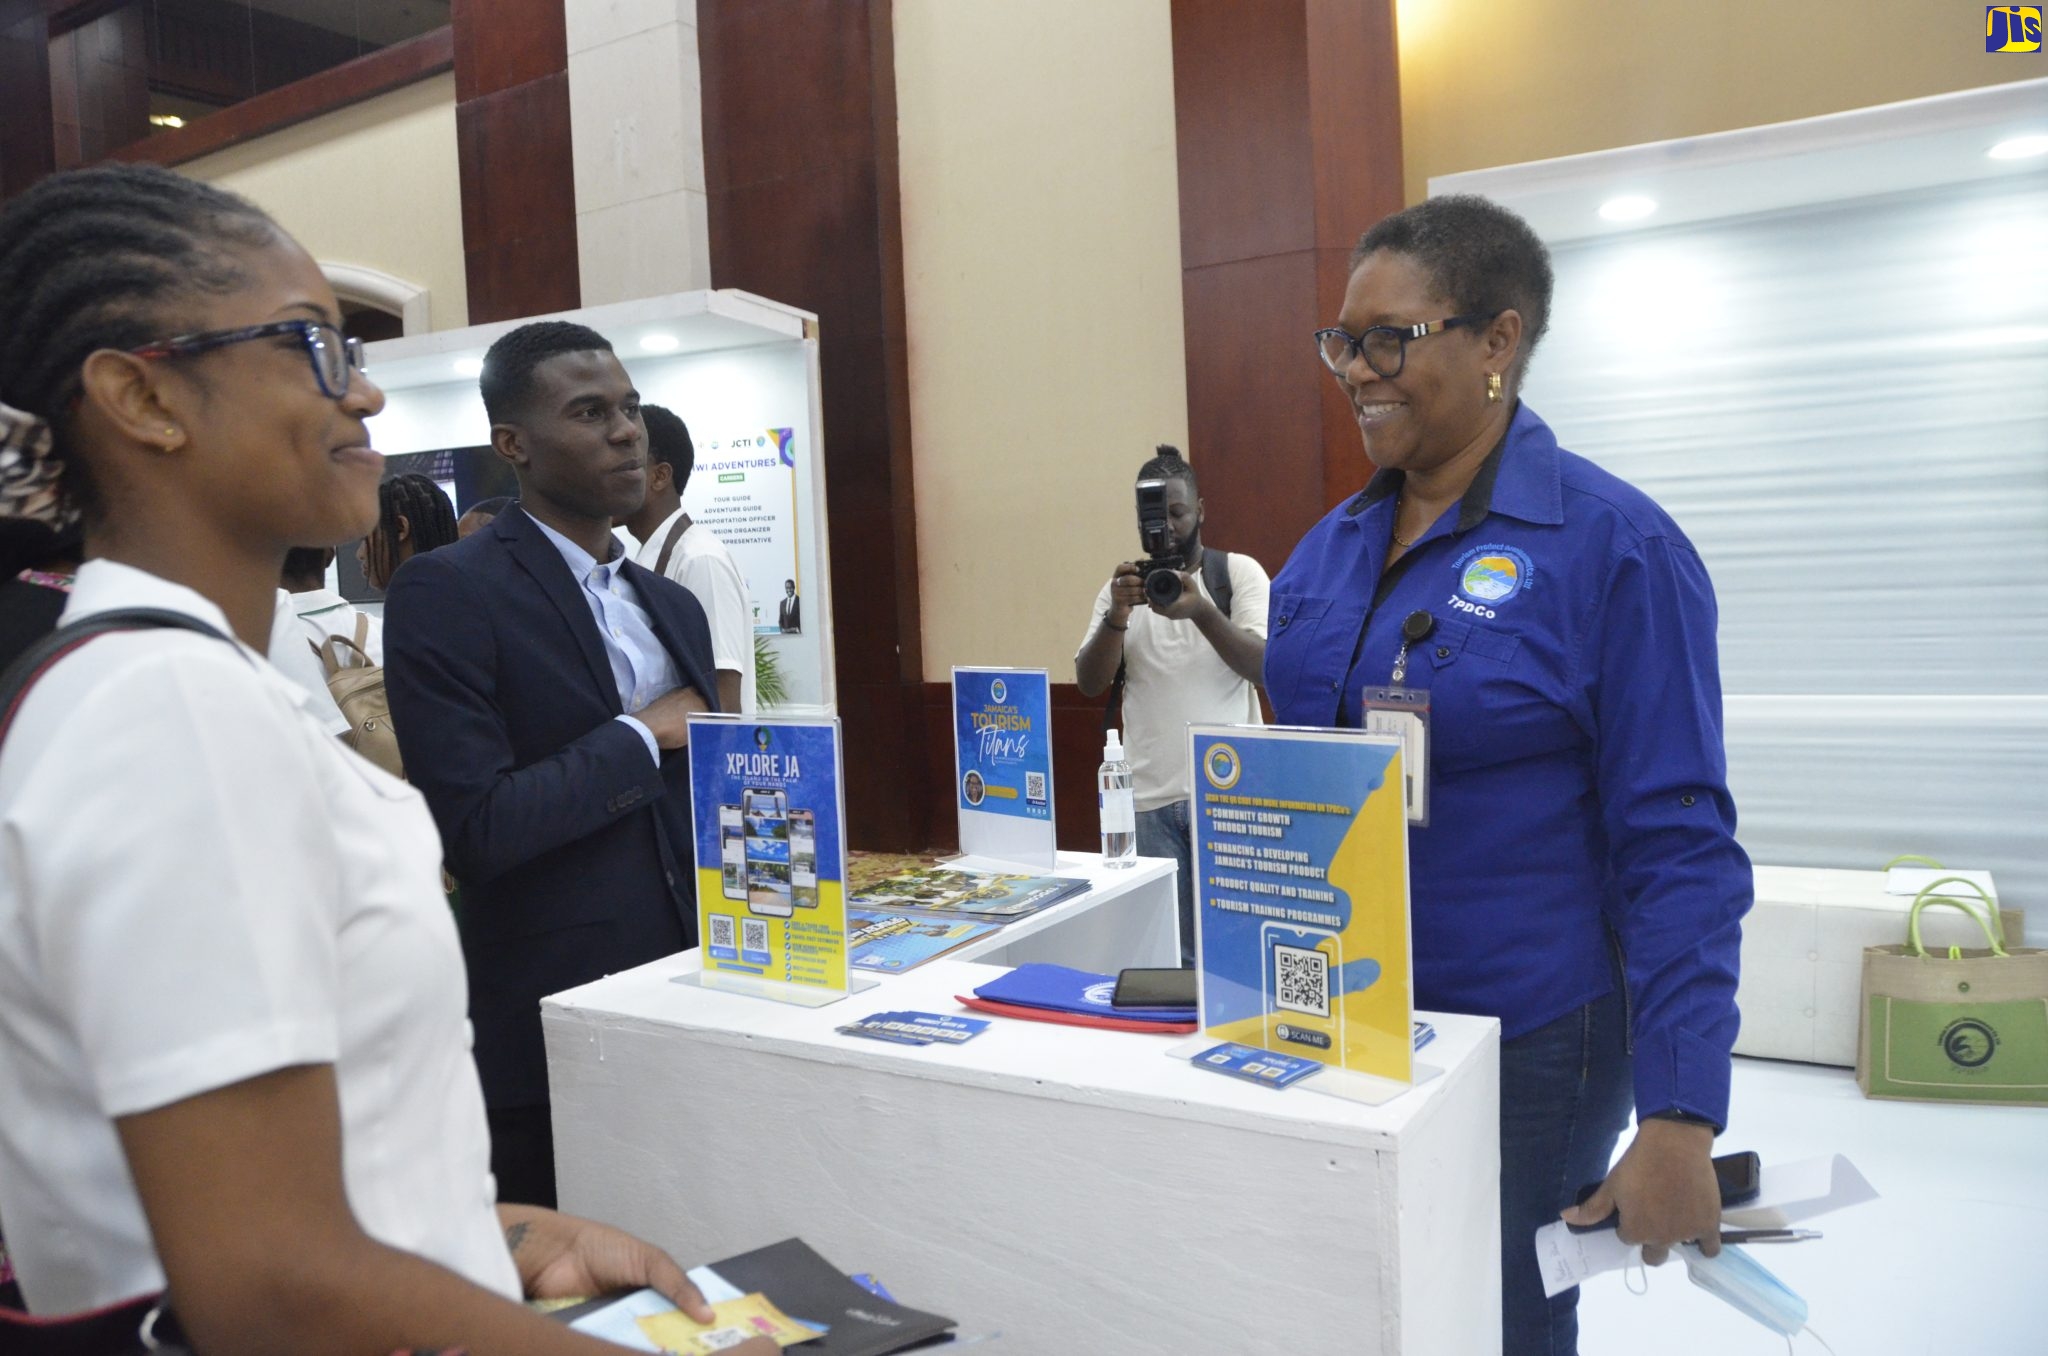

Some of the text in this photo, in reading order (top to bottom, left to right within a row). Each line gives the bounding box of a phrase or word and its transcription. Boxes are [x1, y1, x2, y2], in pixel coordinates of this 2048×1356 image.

[731, 439, 751, 448] JCTI
[711, 458, 776, 470] ADVENTURES
[1476, 543, 1504, 552] Product
[1448, 594, 1495, 619] TPDCo
[984, 704, 1018, 714] JAMAICA'S
[971, 712, 1031, 732] TOURISM
[975, 723, 1030, 766] Titans
[726, 753, 800, 778] XPLORE JA
[1212, 808, 1290, 825] COMMUNITY GROWTH
[1213, 821, 1282, 837] THROUGH TOURISM
[1214, 842, 1309, 863] ENHANCING & DEVELOPING
[1215, 855, 1325, 879] JAMAICA'S TOURISM PRODUCT
[1215, 877, 1334, 903] PRODUCT QUALITY AND TRAINING
[1216, 898, 1341, 927] TOURISM TRAINING PROGRAMMES
[1291, 1031, 1324, 1045] SCAN ME
